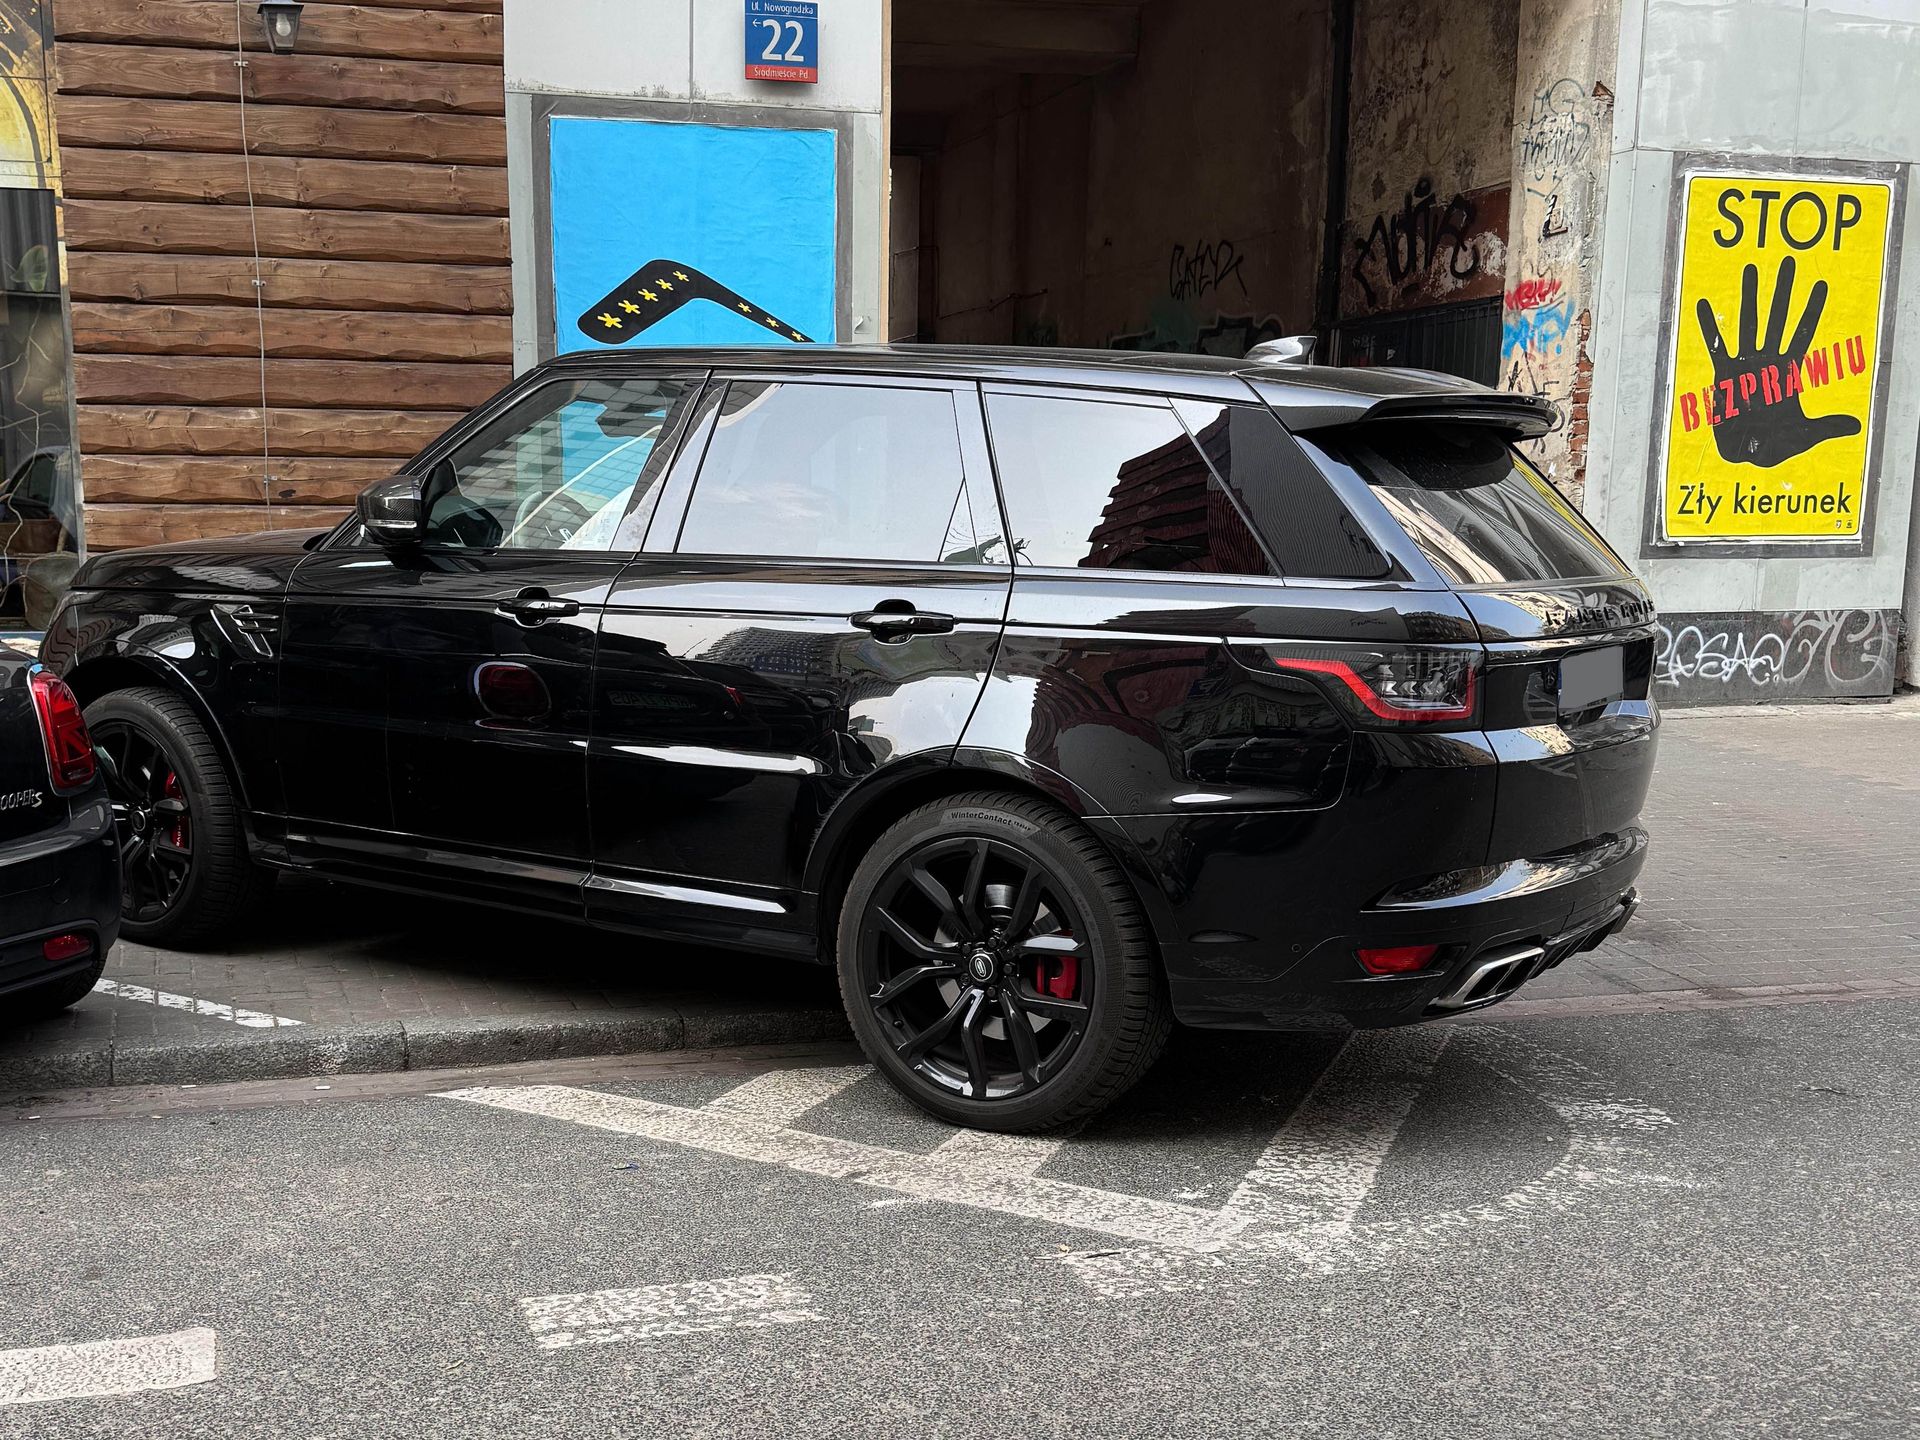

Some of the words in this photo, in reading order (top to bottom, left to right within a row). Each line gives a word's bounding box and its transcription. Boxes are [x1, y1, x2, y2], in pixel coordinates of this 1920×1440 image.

[764, 2, 814, 15] Nowogrodzka
[762, 19, 804, 62] 22
[1713, 188, 1862, 251] STOP
[1680, 335, 1866, 432] BEZPRAWIU
[1733, 482, 1852, 514] kierunek
[951, 811, 1012, 826] WinterContact
